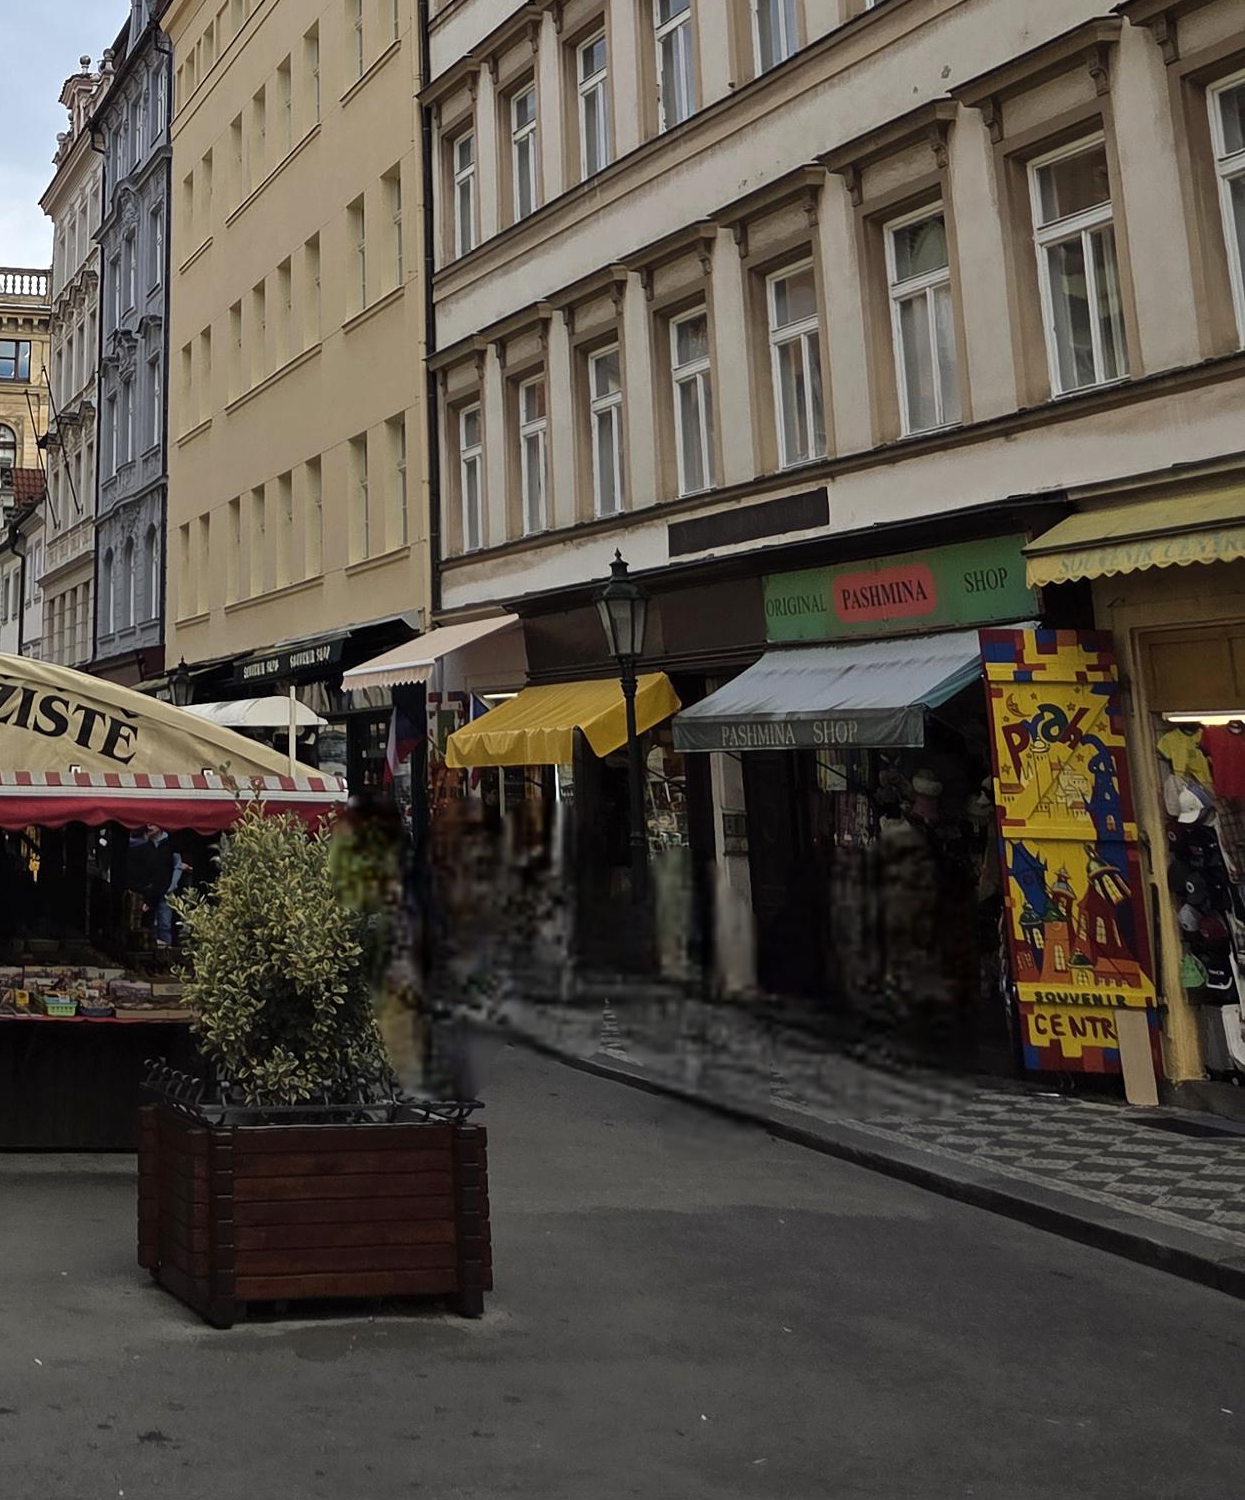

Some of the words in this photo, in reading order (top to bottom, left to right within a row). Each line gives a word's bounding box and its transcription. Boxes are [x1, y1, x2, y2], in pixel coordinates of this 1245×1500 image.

[1162, 529, 1245, 560] CENTR
[765, 593, 827, 618] ORIGINAL
[841, 579, 928, 611] PASHMINA
[963, 567, 1008, 594] SHOP
[721, 722, 796, 746] PASHMINA
[813, 720, 858, 743] SHOP
[1034, 991, 1126, 1007] SOUVENIR
[1034, 1013, 1119, 1040] CENTR
